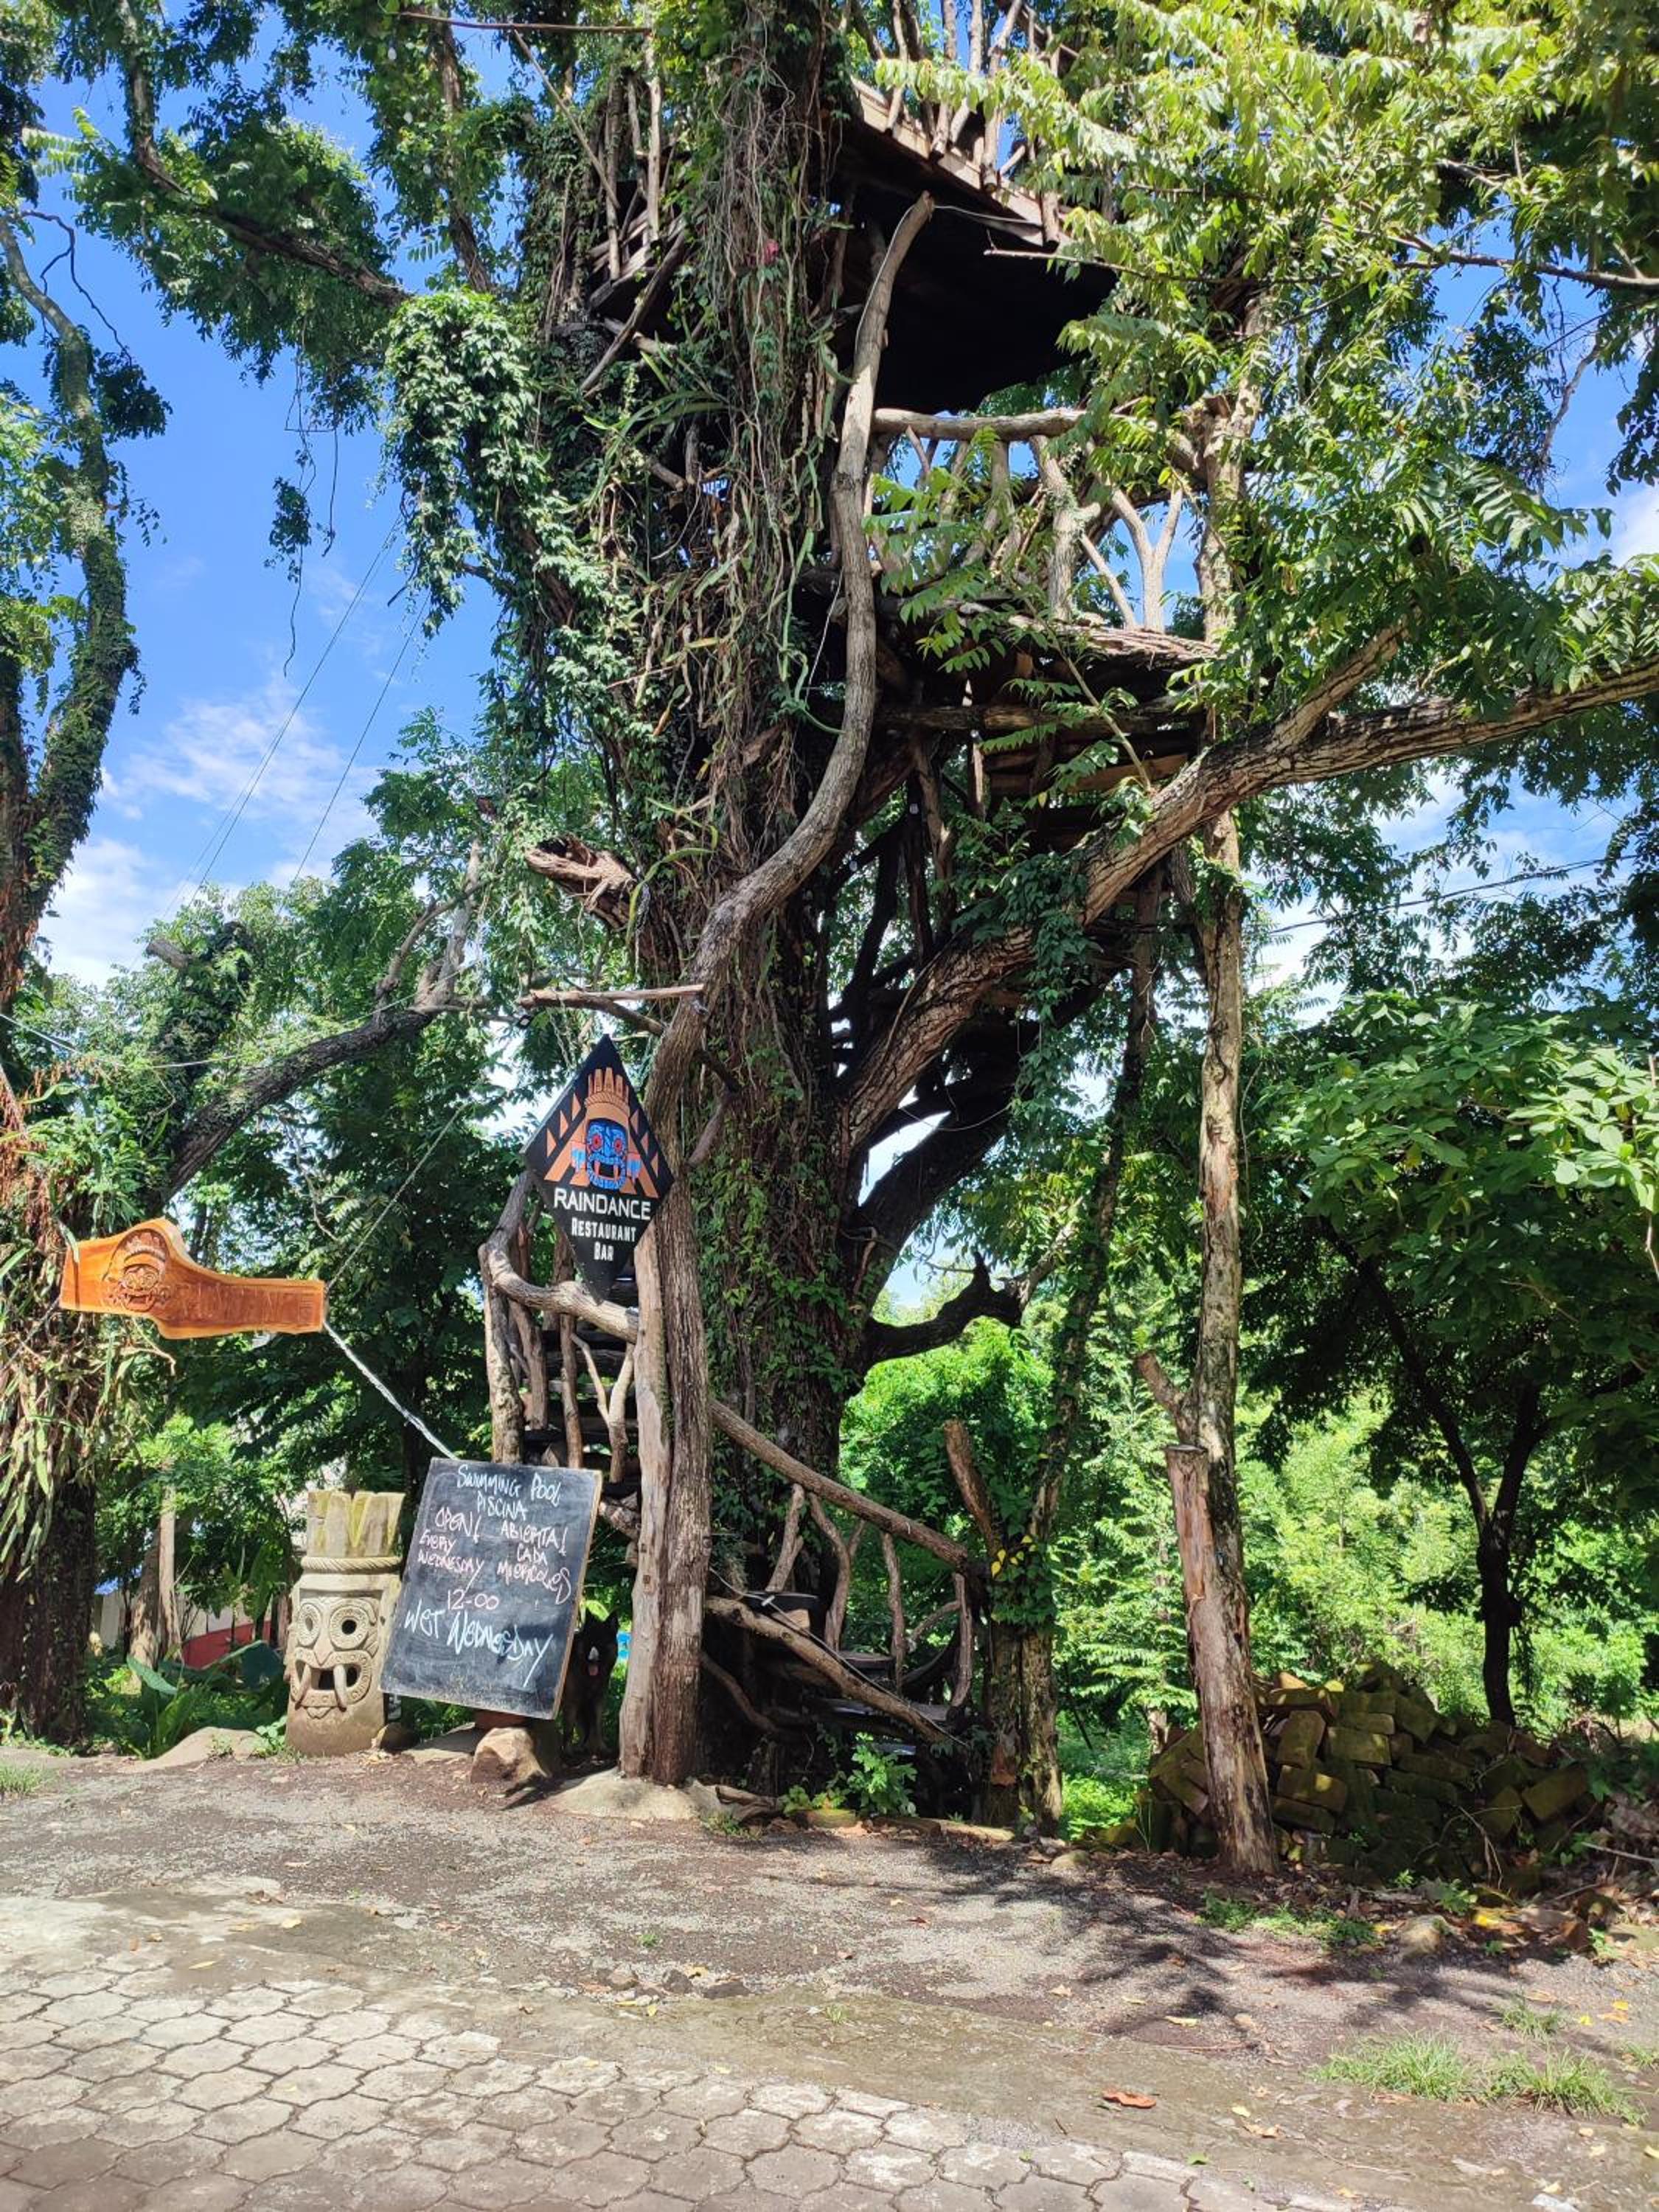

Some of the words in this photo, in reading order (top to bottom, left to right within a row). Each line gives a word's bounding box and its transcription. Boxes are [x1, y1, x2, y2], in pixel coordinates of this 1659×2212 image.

[554, 1187, 651, 1220] RAINDANCE
[571, 1217, 636, 1242] RESTAURANT
[594, 1242, 614, 1262] BAR
[477, 1490, 529, 1521] PISCINA
[517, 1543, 548, 1566] CADA
